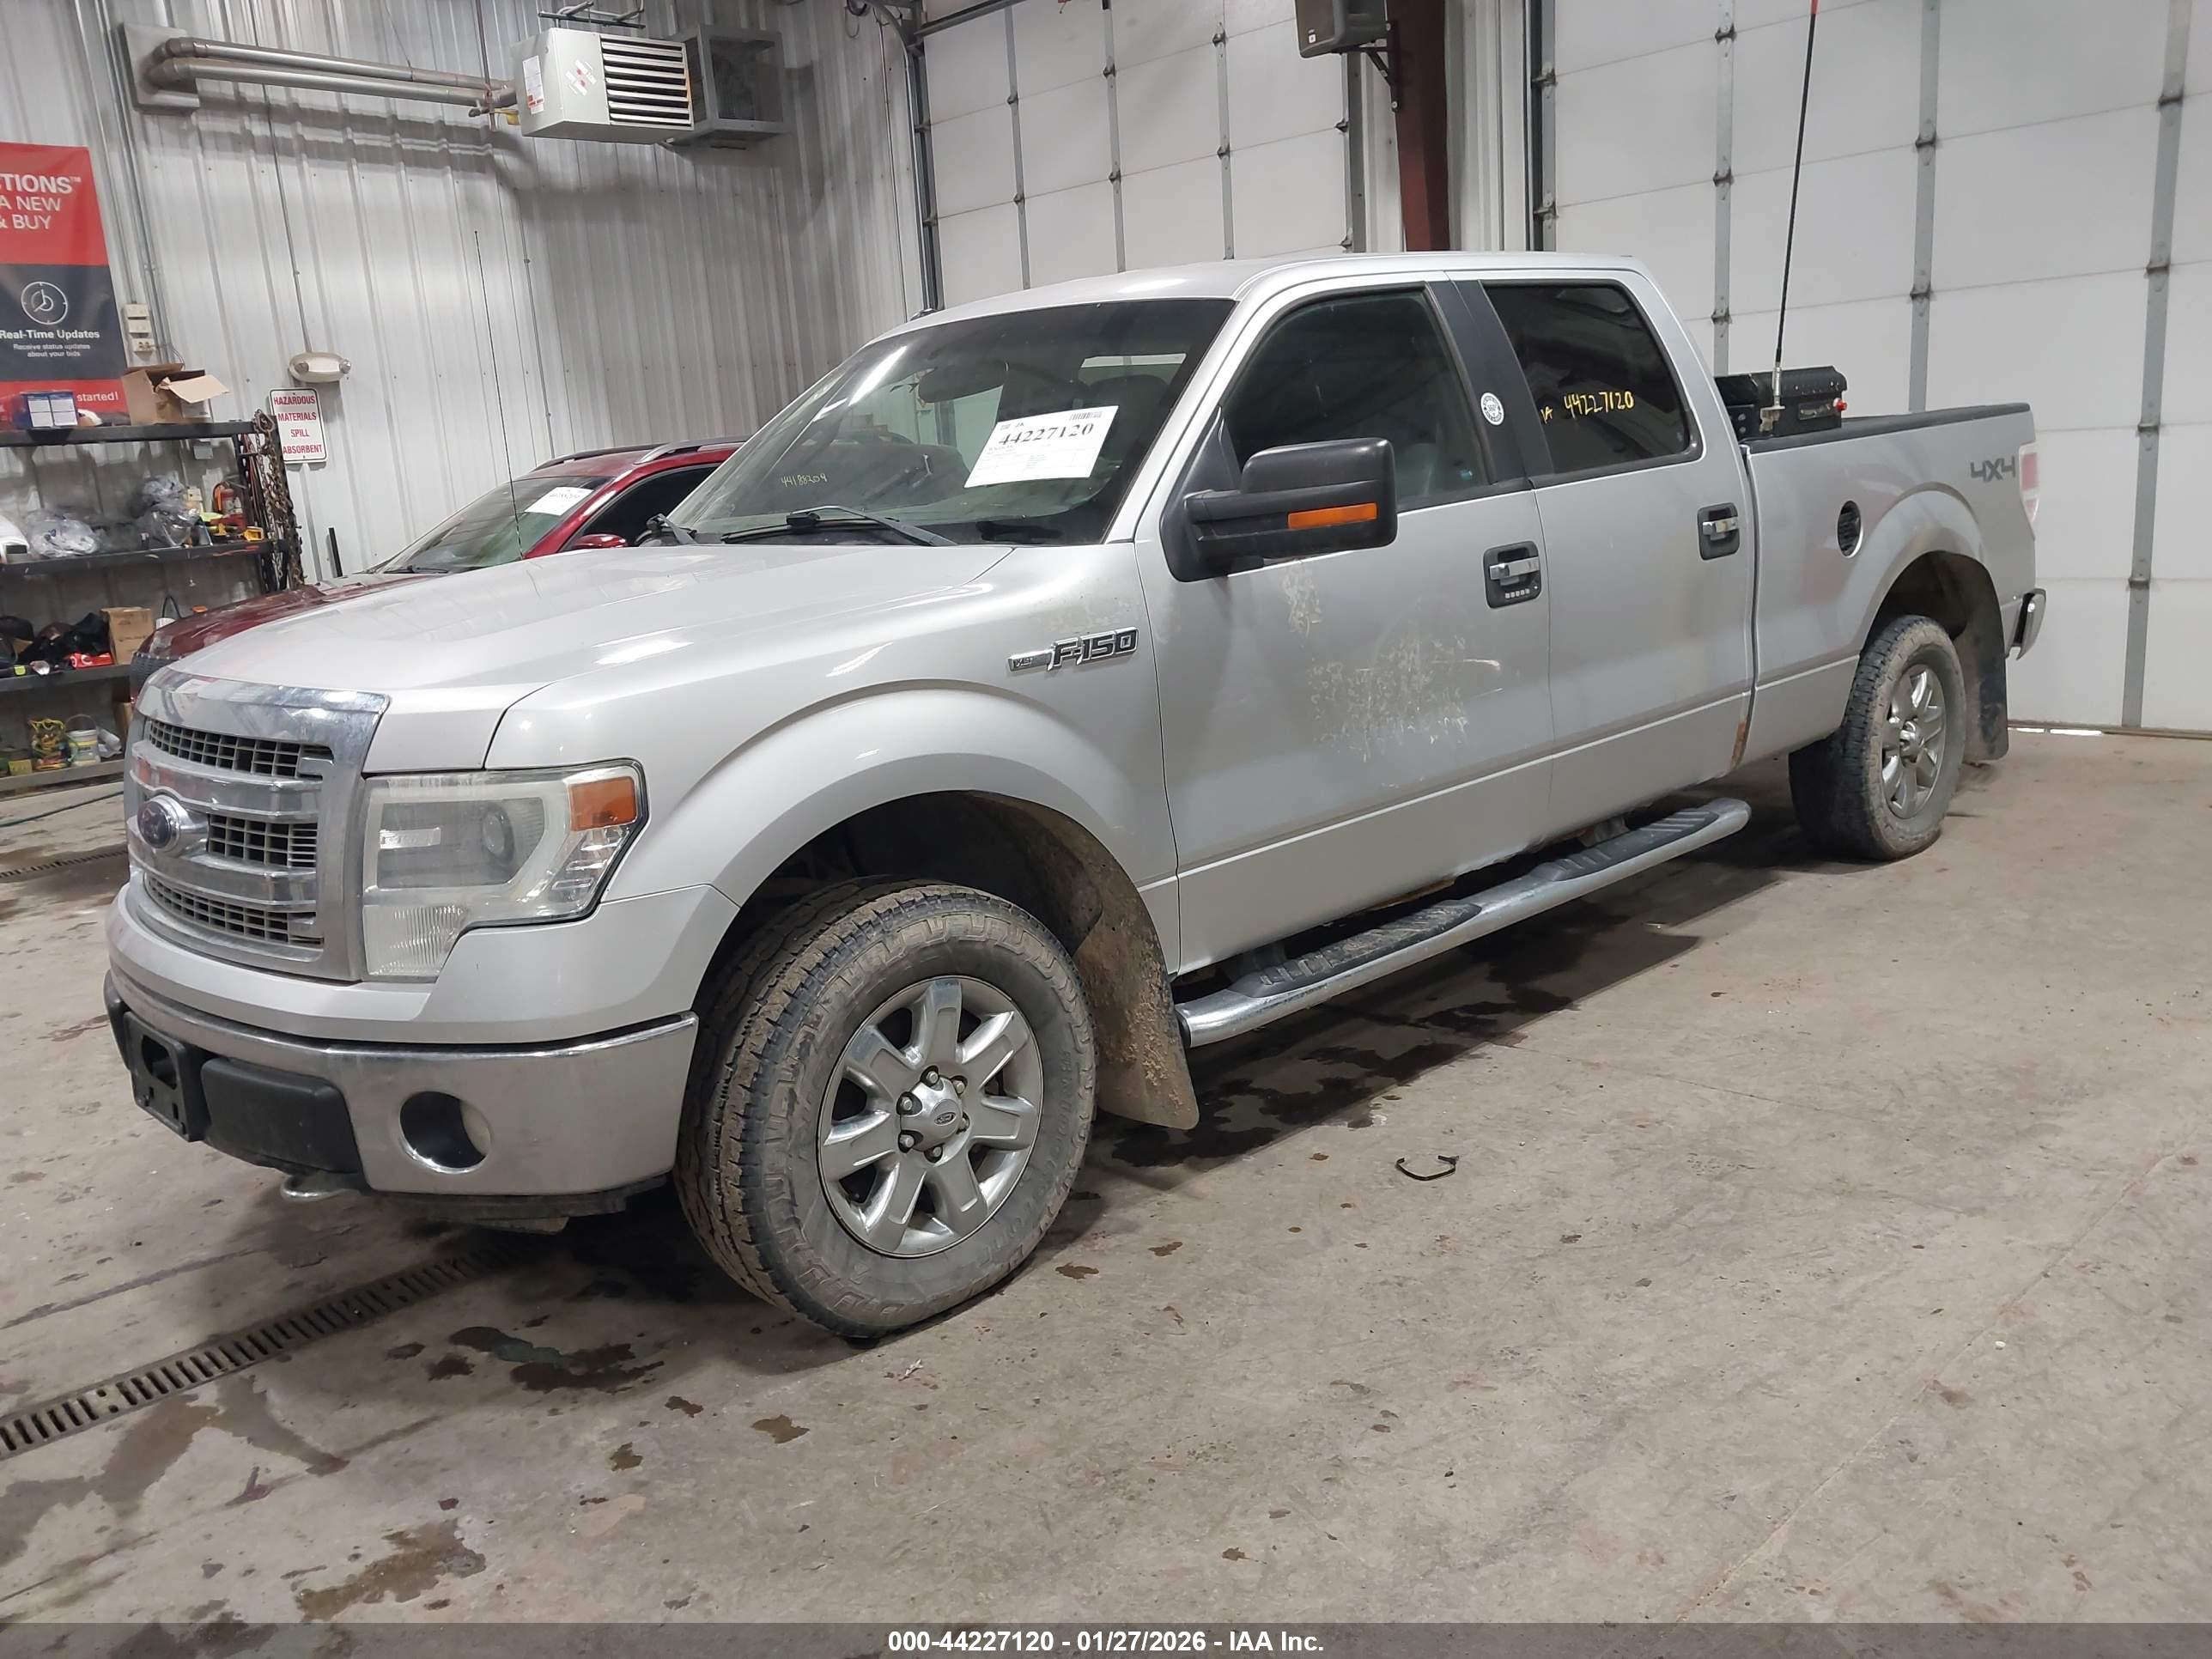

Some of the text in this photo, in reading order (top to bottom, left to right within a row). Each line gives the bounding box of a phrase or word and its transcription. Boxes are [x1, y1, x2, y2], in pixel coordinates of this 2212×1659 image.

[16, 196, 61, 211] NEW
[12, 214, 51, 229] BUY
[0, 329, 100, 340] Real-Time Updates
[76, 392, 118, 402] started!
[273, 395, 316, 405] HAZARDOUS
[1564, 391, 1634, 419] 44227120
[278, 412, 317, 421] MATERIALS
[290, 428, 310, 438] SPILL
[998, 422, 1095, 446] 44227120
[283, 444, 323, 454] ABSORBENT
[781, 473, 828, 488] 44188209
